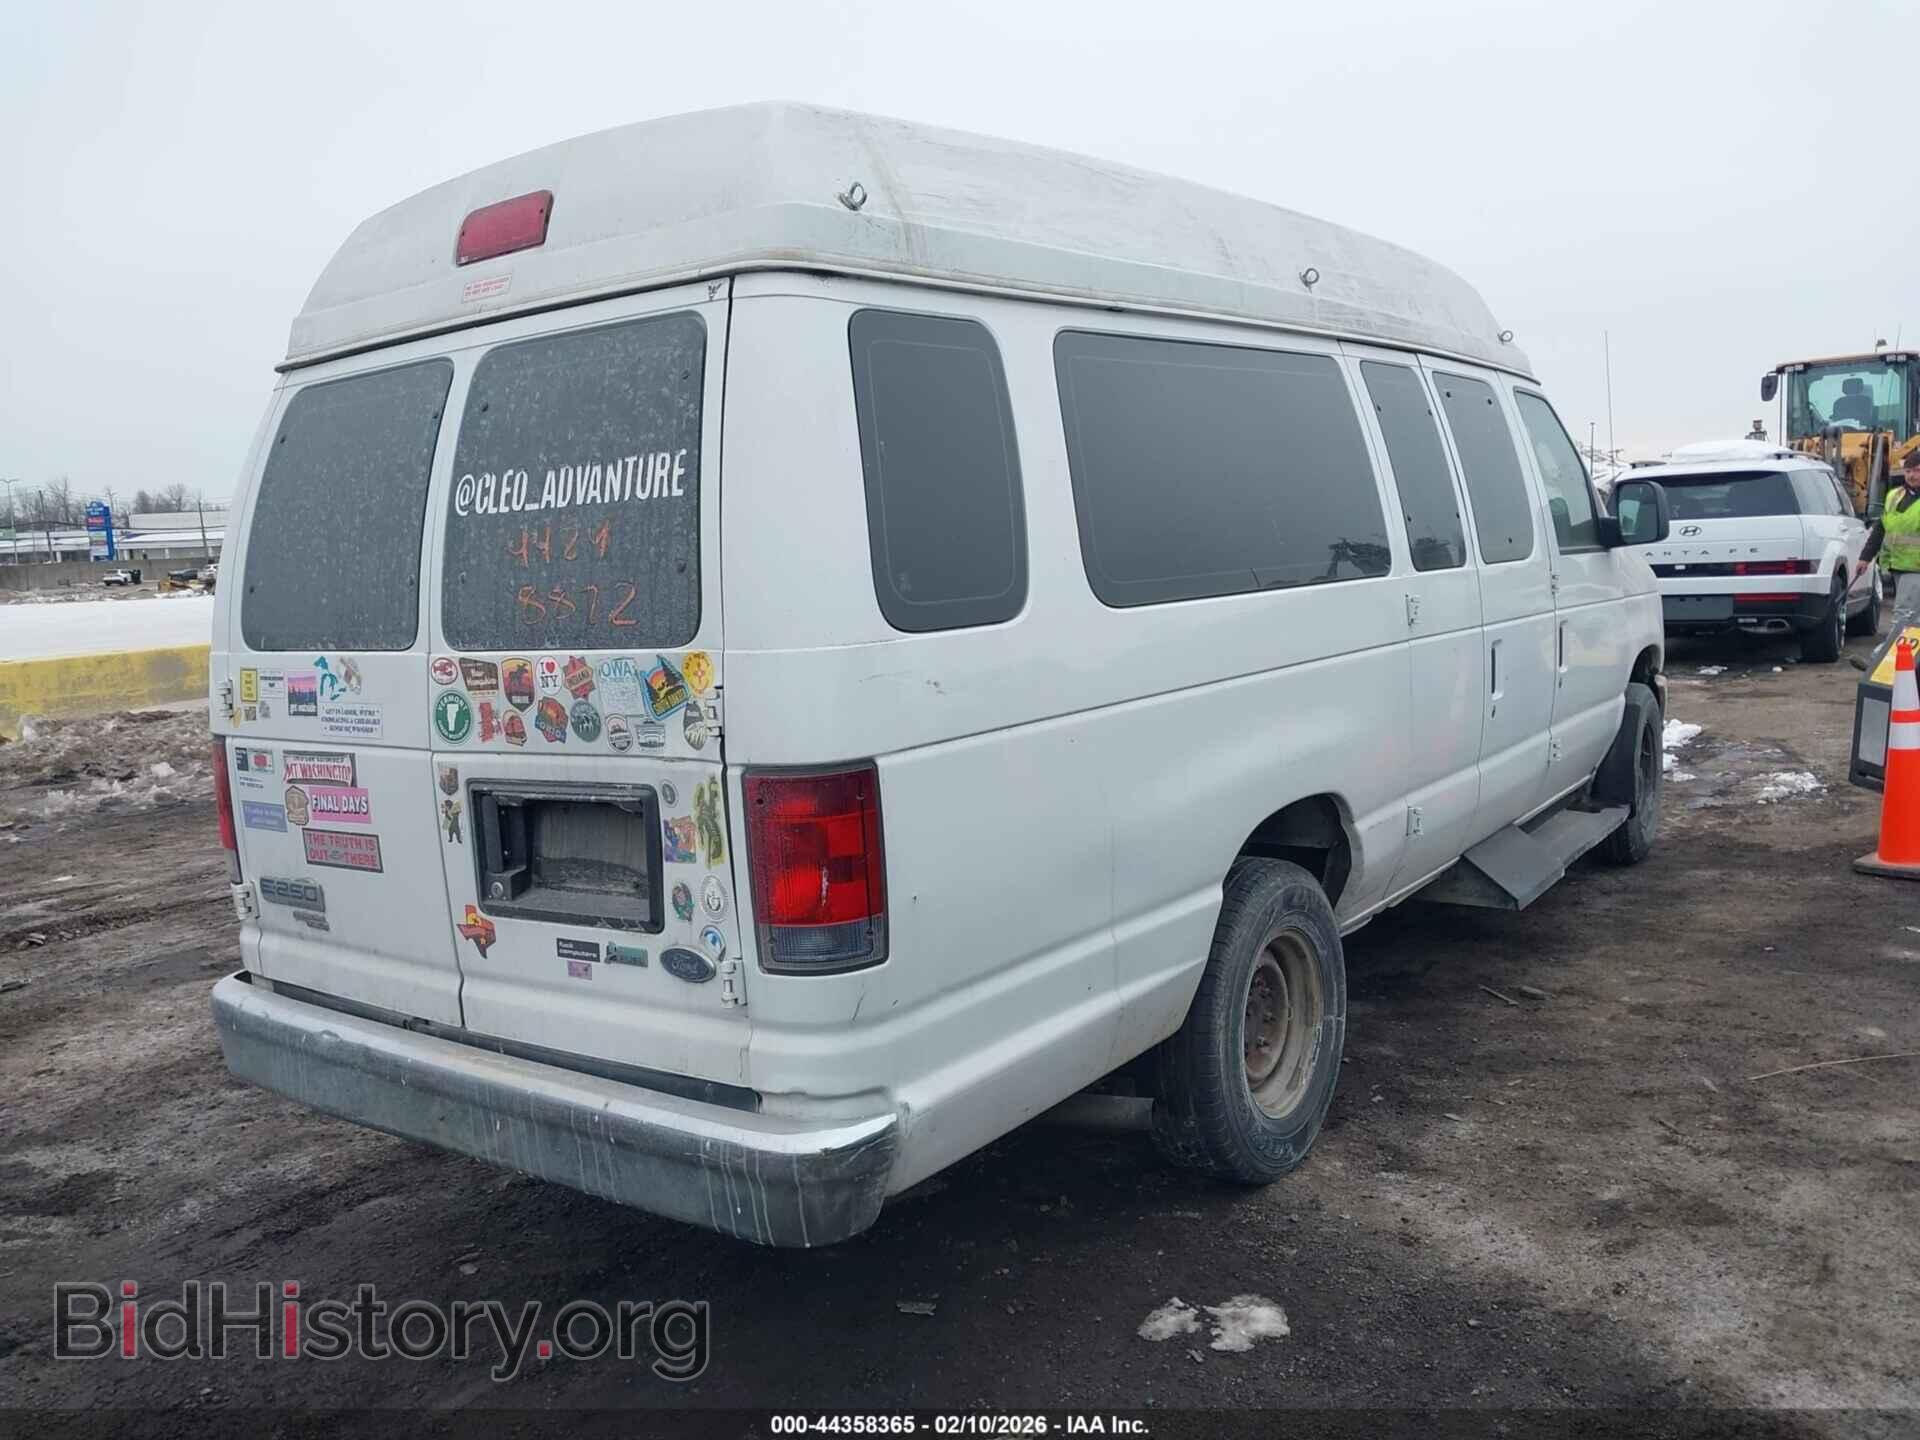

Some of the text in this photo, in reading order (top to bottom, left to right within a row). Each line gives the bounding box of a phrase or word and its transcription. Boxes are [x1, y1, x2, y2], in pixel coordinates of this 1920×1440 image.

[454, 448, 687, 516] @CLEO_ADVANTURE
[1645, 549, 1710, 557] ANTA
[540, 662, 546, 675] I
[540, 674, 559, 688] NY
[437, 694, 468, 711] VERMONT
[297, 763, 352, 782] WASHINGTON
[312, 795, 368, 815] FINAL DAYS
[307, 832, 377, 851] THE TRUTH IS
[309, 848, 378, 867] OUT THERE
